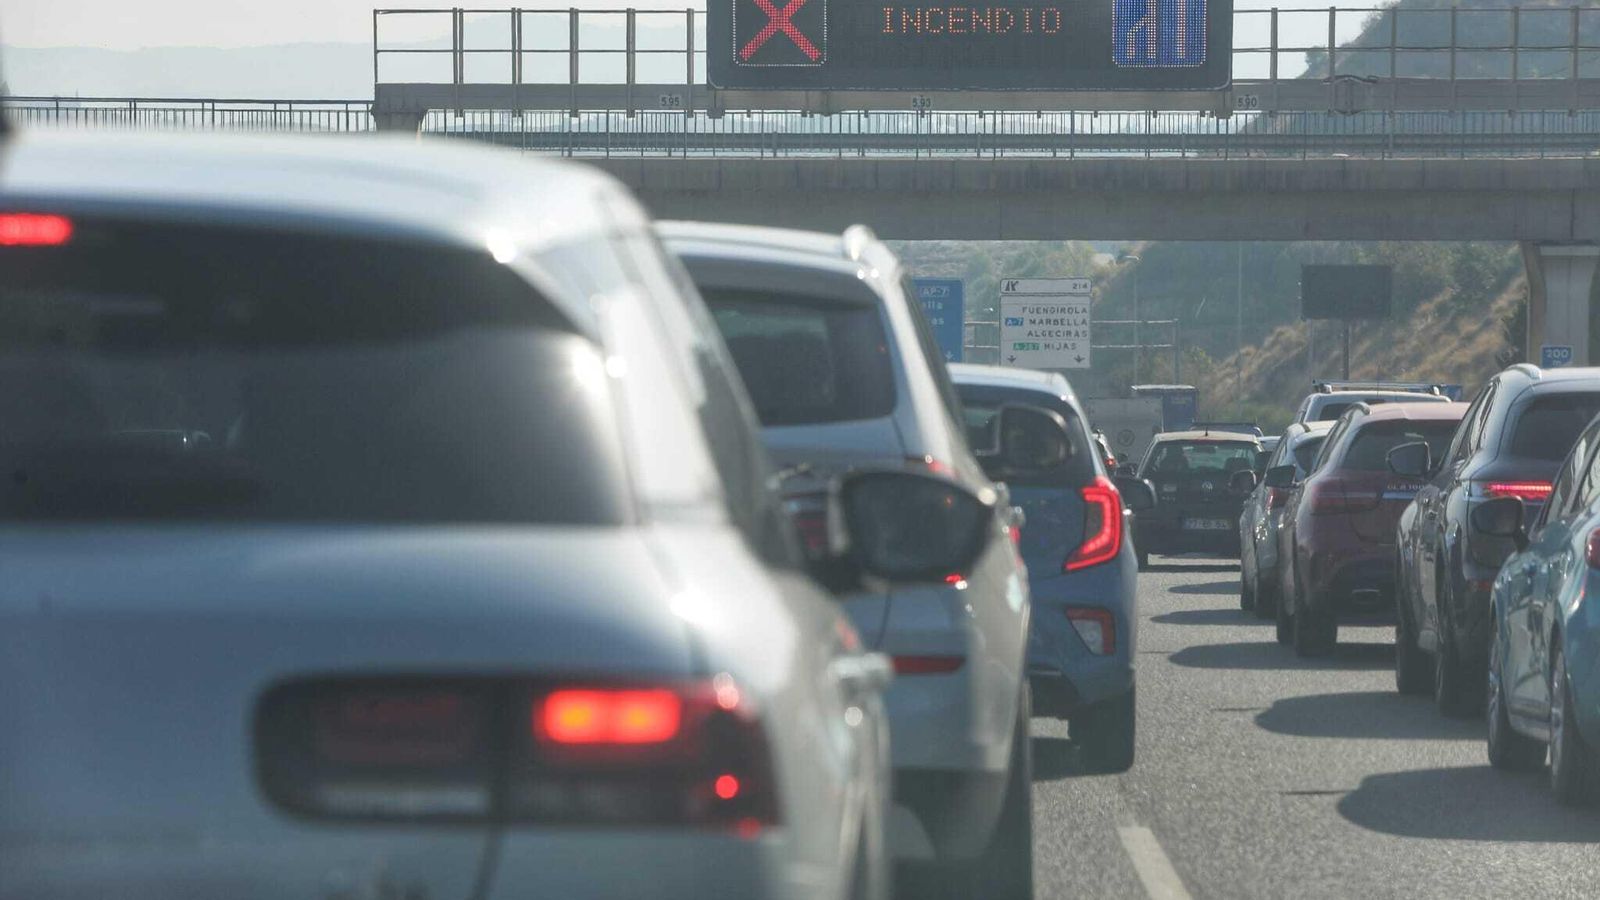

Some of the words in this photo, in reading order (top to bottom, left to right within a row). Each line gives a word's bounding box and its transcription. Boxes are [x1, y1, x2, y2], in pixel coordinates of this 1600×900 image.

[882, 7, 1061, 34] INCENDIO
[1072, 282, 1088, 290] 214
[1022, 306, 1088, 315] FUENGIROLA
[1006, 317, 1024, 327] A-7
[1028, 318, 1088, 326] MARBELLA
[1027, 330, 1088, 338] ALGECIRAS
[1043, 342, 1077, 350] MIJAS
[1544, 348, 1569, 359] 200
